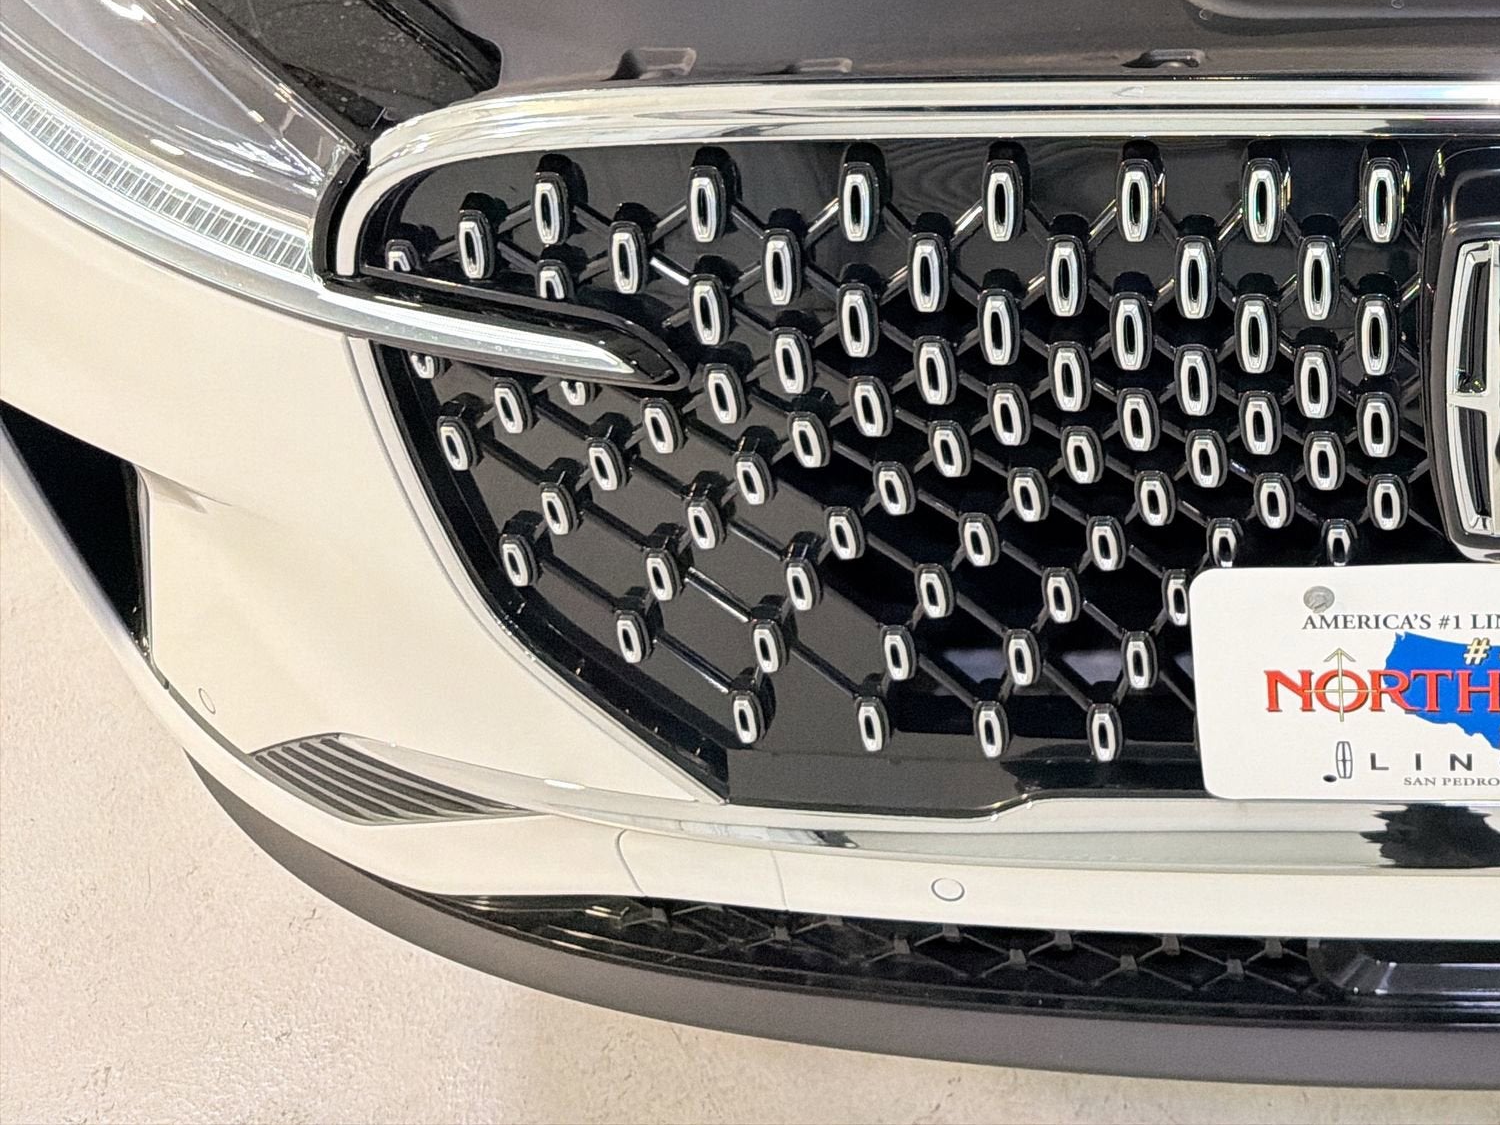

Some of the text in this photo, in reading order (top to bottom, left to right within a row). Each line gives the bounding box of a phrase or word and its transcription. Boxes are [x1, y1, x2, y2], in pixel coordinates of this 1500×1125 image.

[1301, 613, 1432, 630] AMERICA'S
[1438, 614, 1461, 630] #1
[1402, 776, 1437, 787] SAN
[1441, 777, 1500, 788] PEDRO
